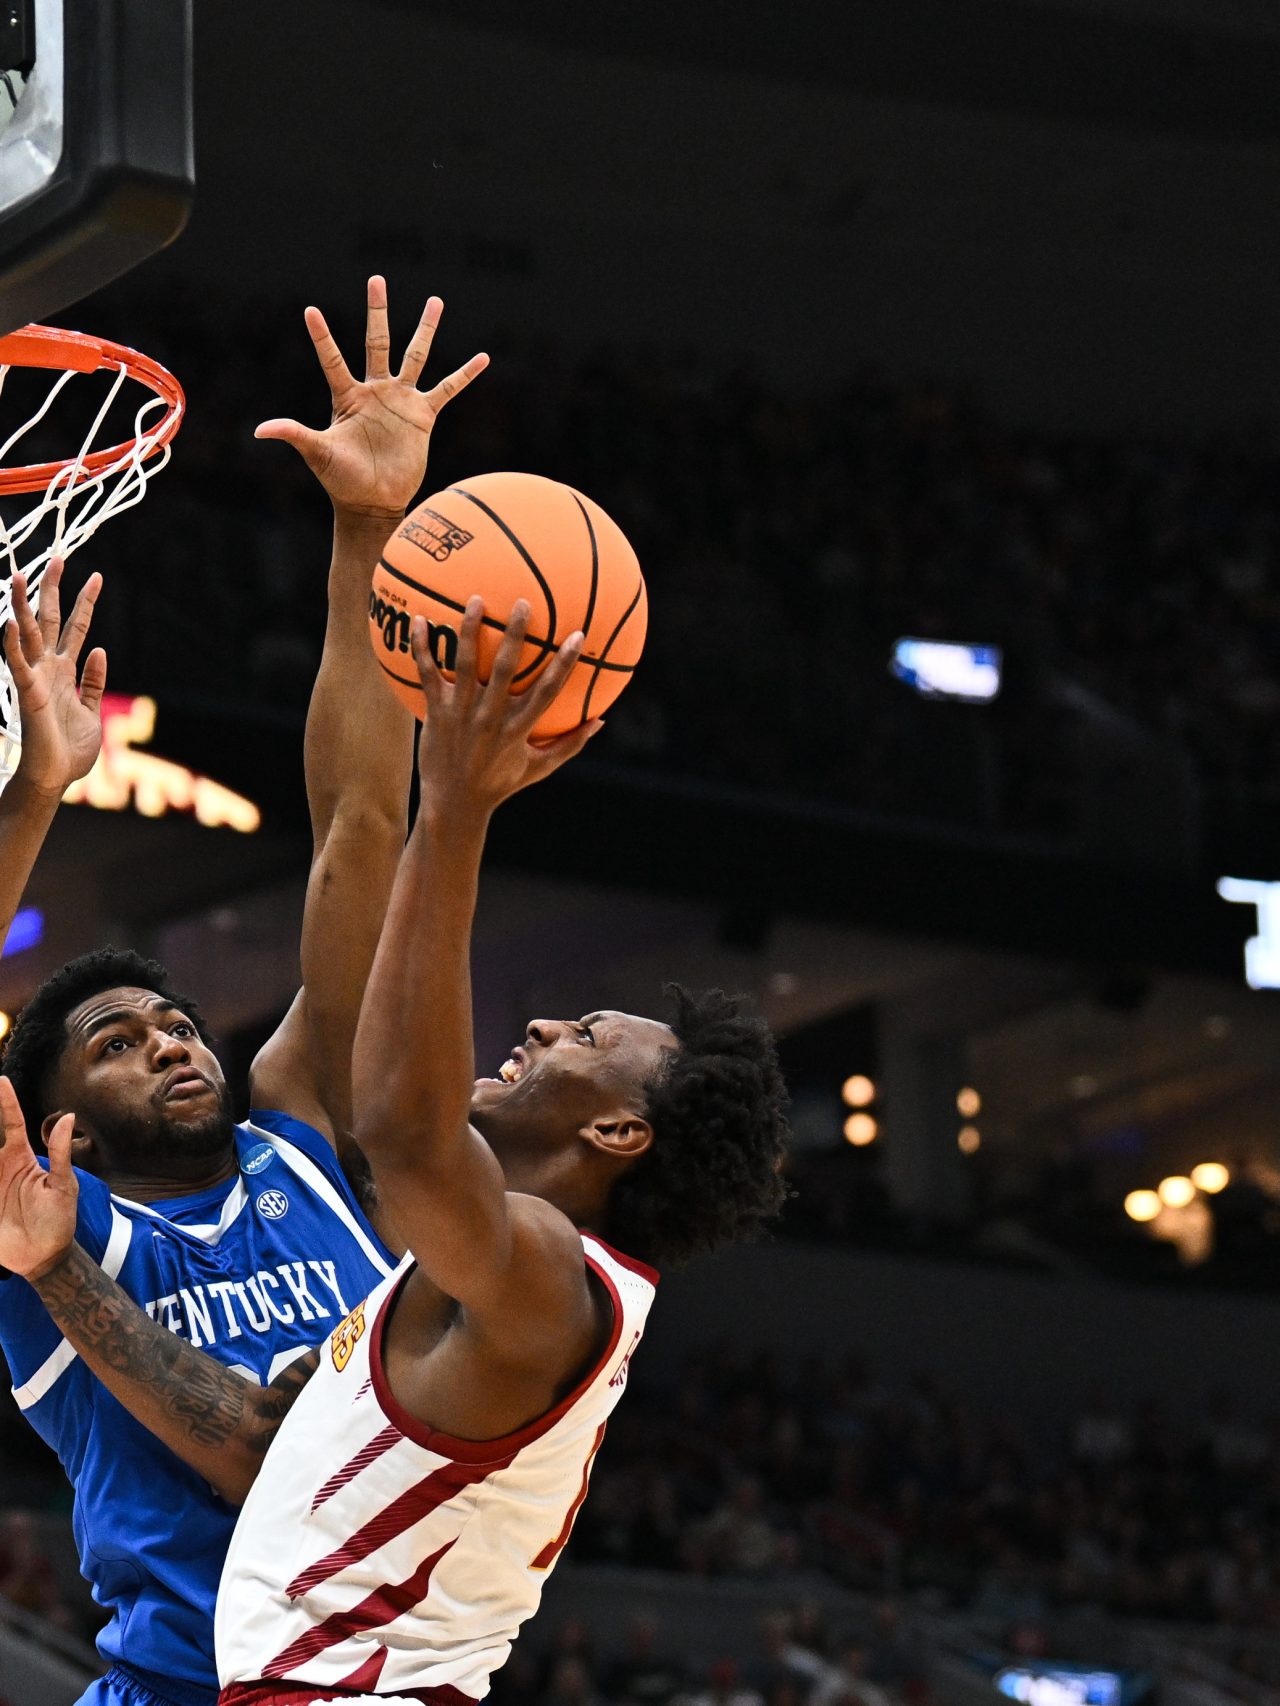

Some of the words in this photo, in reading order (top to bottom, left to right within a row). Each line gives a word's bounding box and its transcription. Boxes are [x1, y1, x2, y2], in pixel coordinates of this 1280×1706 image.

[369, 591, 459, 672] Wilso
[246, 1148, 273, 1172] NCAA
[259, 1191, 286, 1217] SEC
